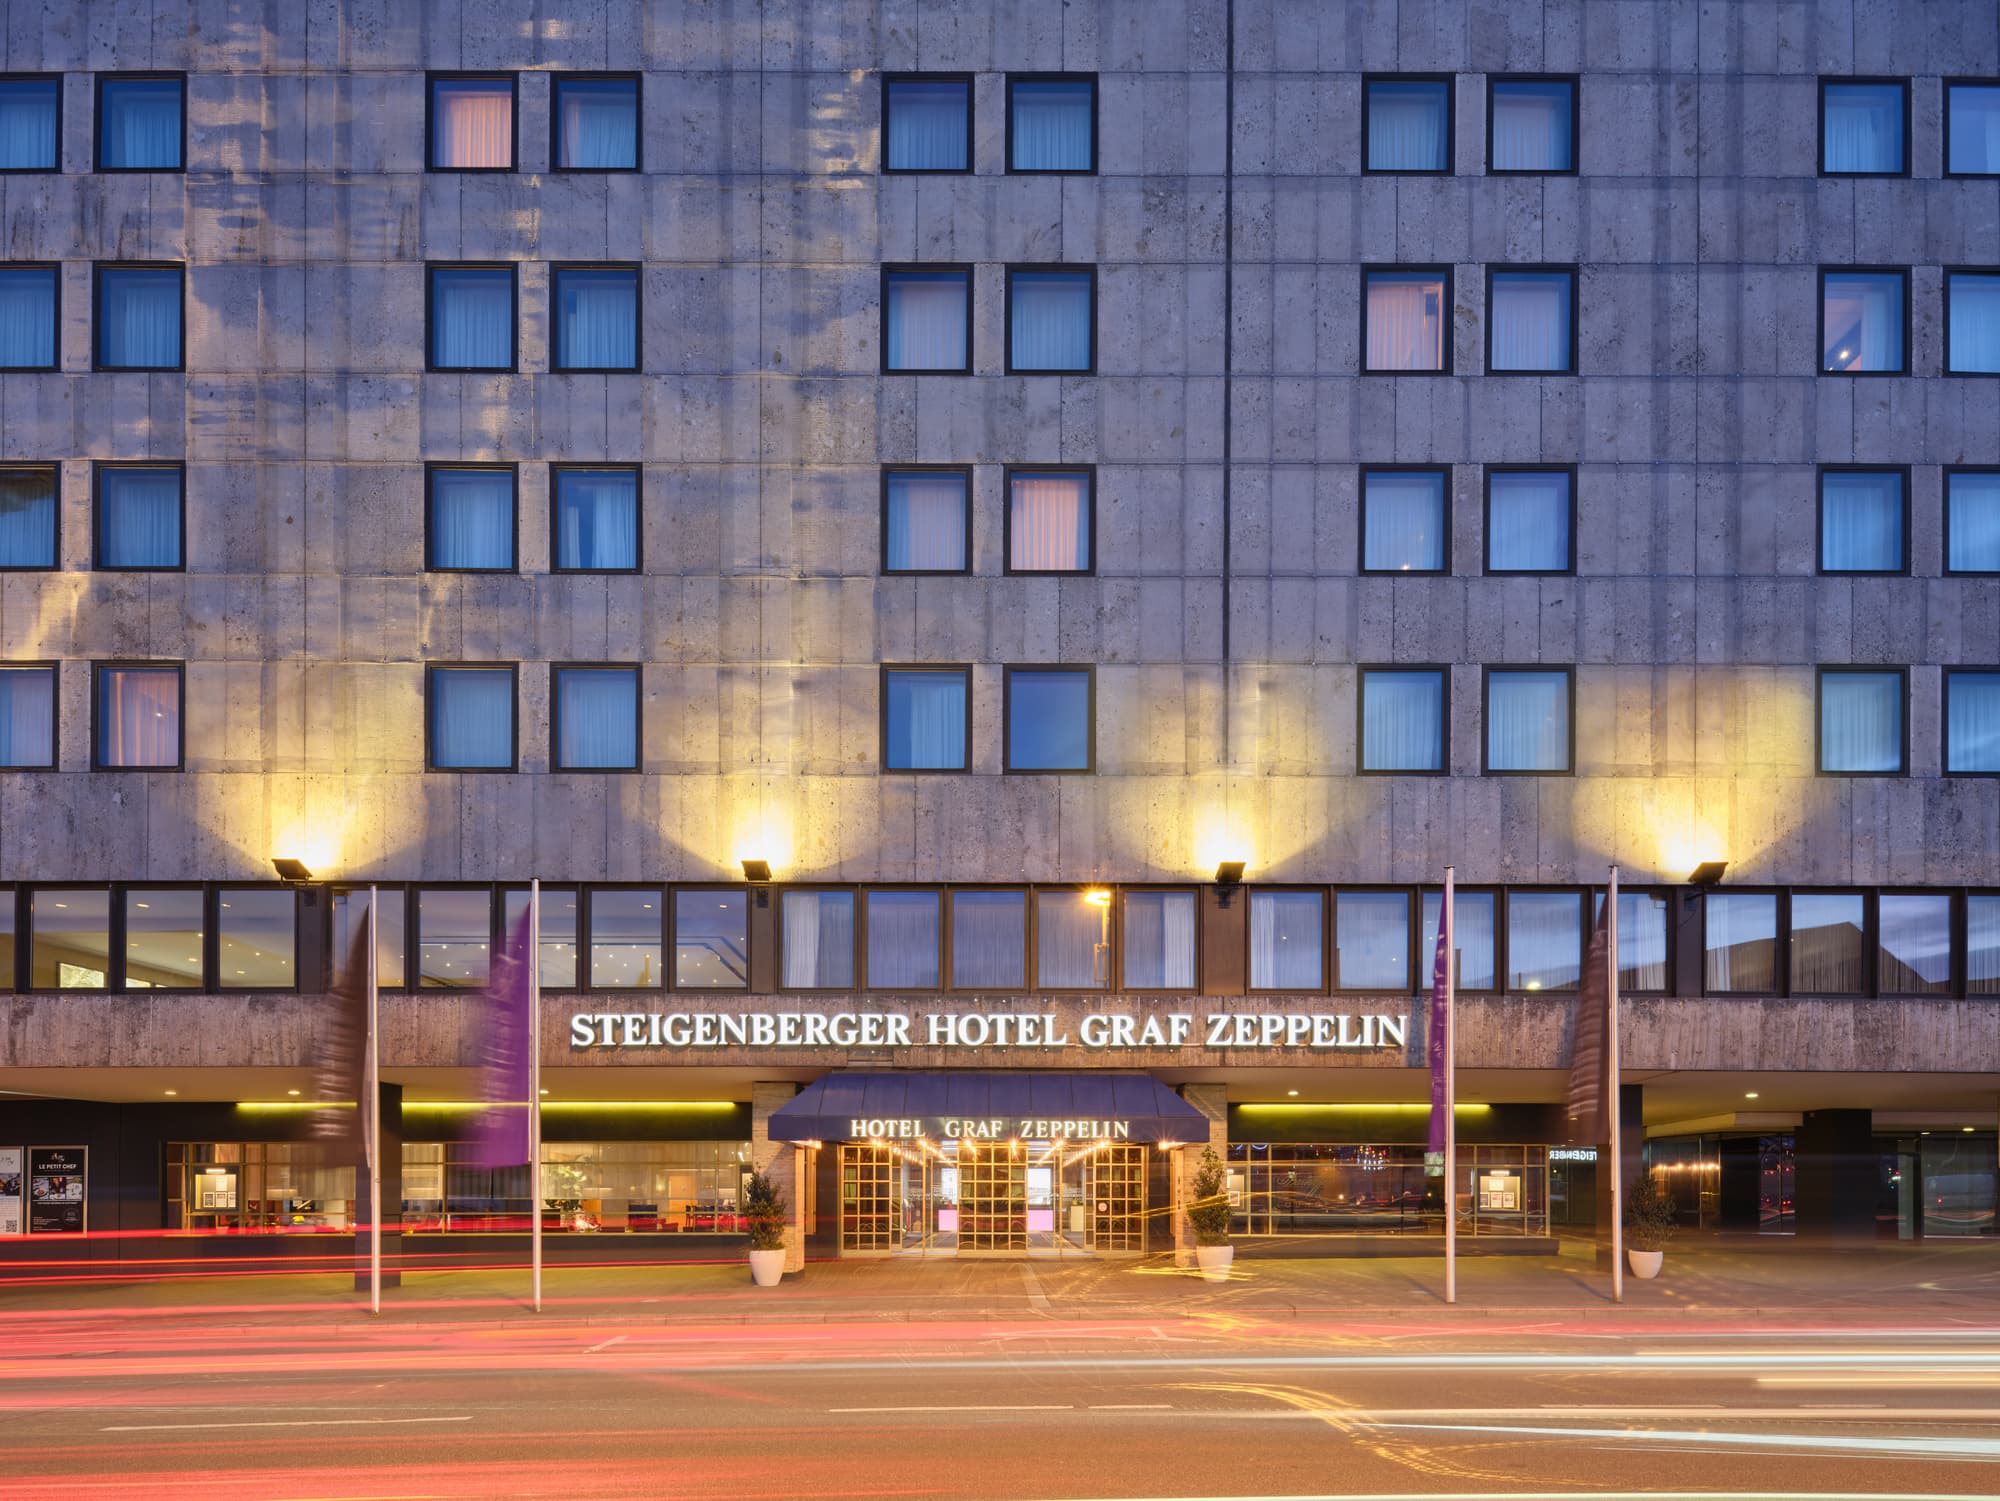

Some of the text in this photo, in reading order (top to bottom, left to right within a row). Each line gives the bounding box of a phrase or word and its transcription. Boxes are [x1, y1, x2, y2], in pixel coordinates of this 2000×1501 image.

[570, 1012, 1408, 1048] STEIGENBERGER HOTEL GRAF ZEPPELIN
[850, 1119, 1130, 1139] HOTEL GRAF ZEPPELIN
